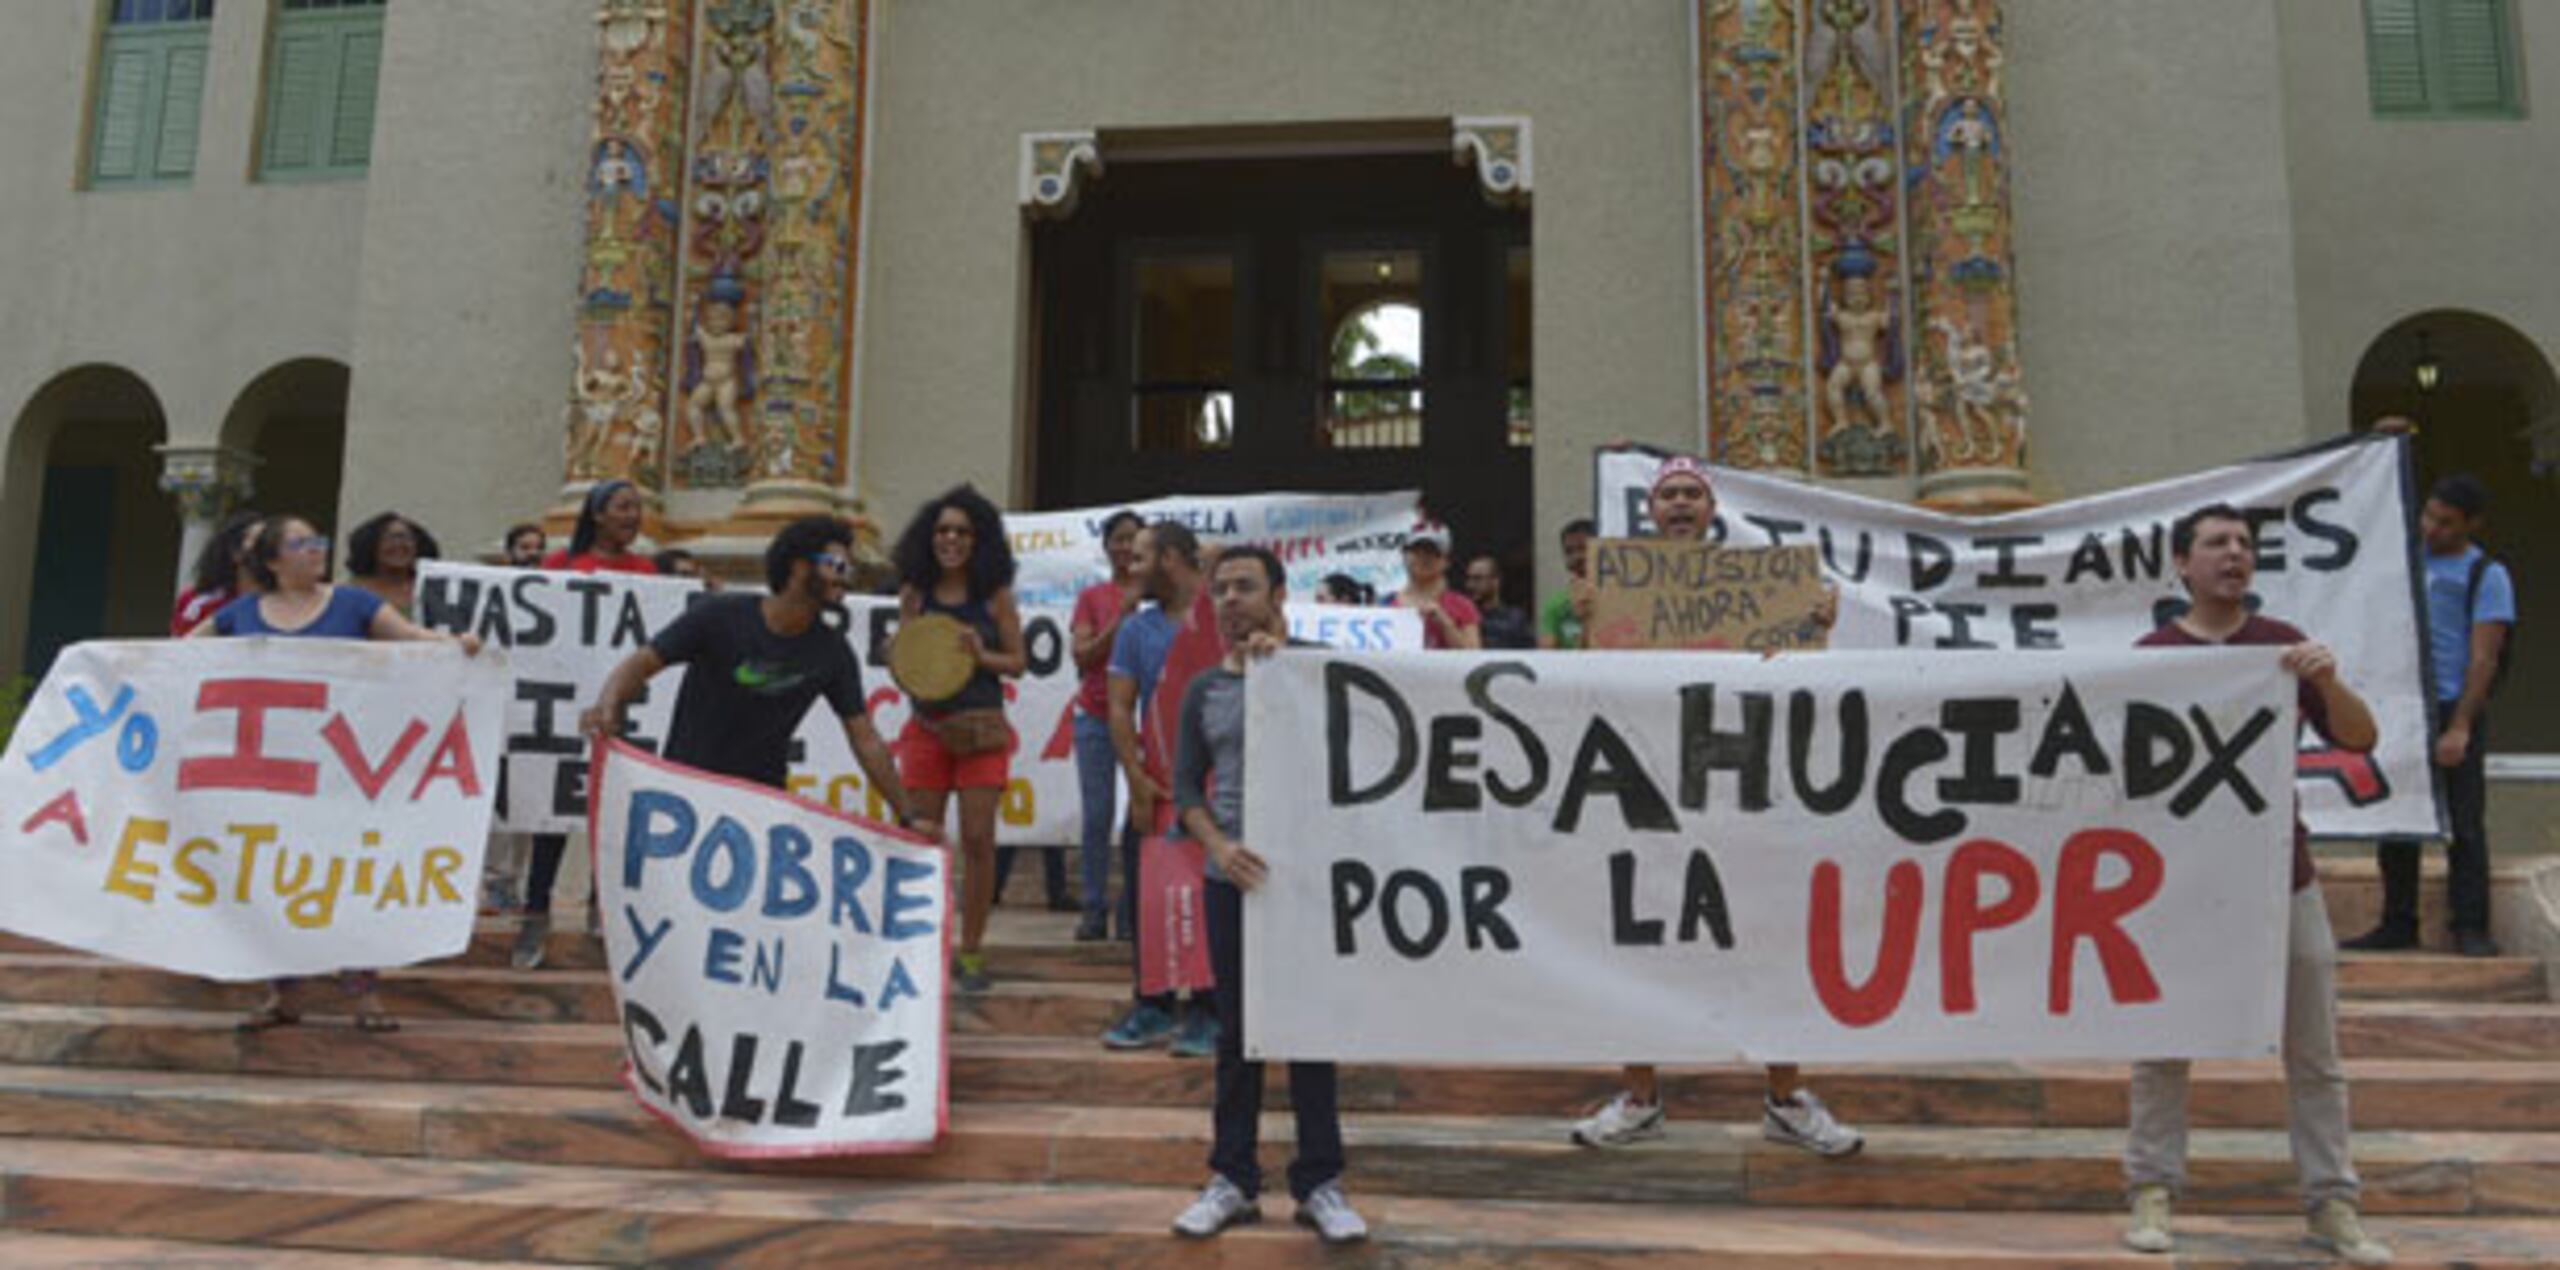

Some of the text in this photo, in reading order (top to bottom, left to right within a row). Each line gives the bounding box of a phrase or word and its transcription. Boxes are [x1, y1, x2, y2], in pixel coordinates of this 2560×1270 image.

[1625, 487, 2358, 591] ETUDIANES
[424, 574, 647, 649] HASTA
[178, 678, 481, 800] IVA
[21, 789, 88, 845] A
[622, 790, 936, 940] POBRE
[621, 903, 920, 1012] Y EN LA
[1330, 827, 2166, 1028] POR LA UPR
[623, 999, 909, 1129] CALLE
